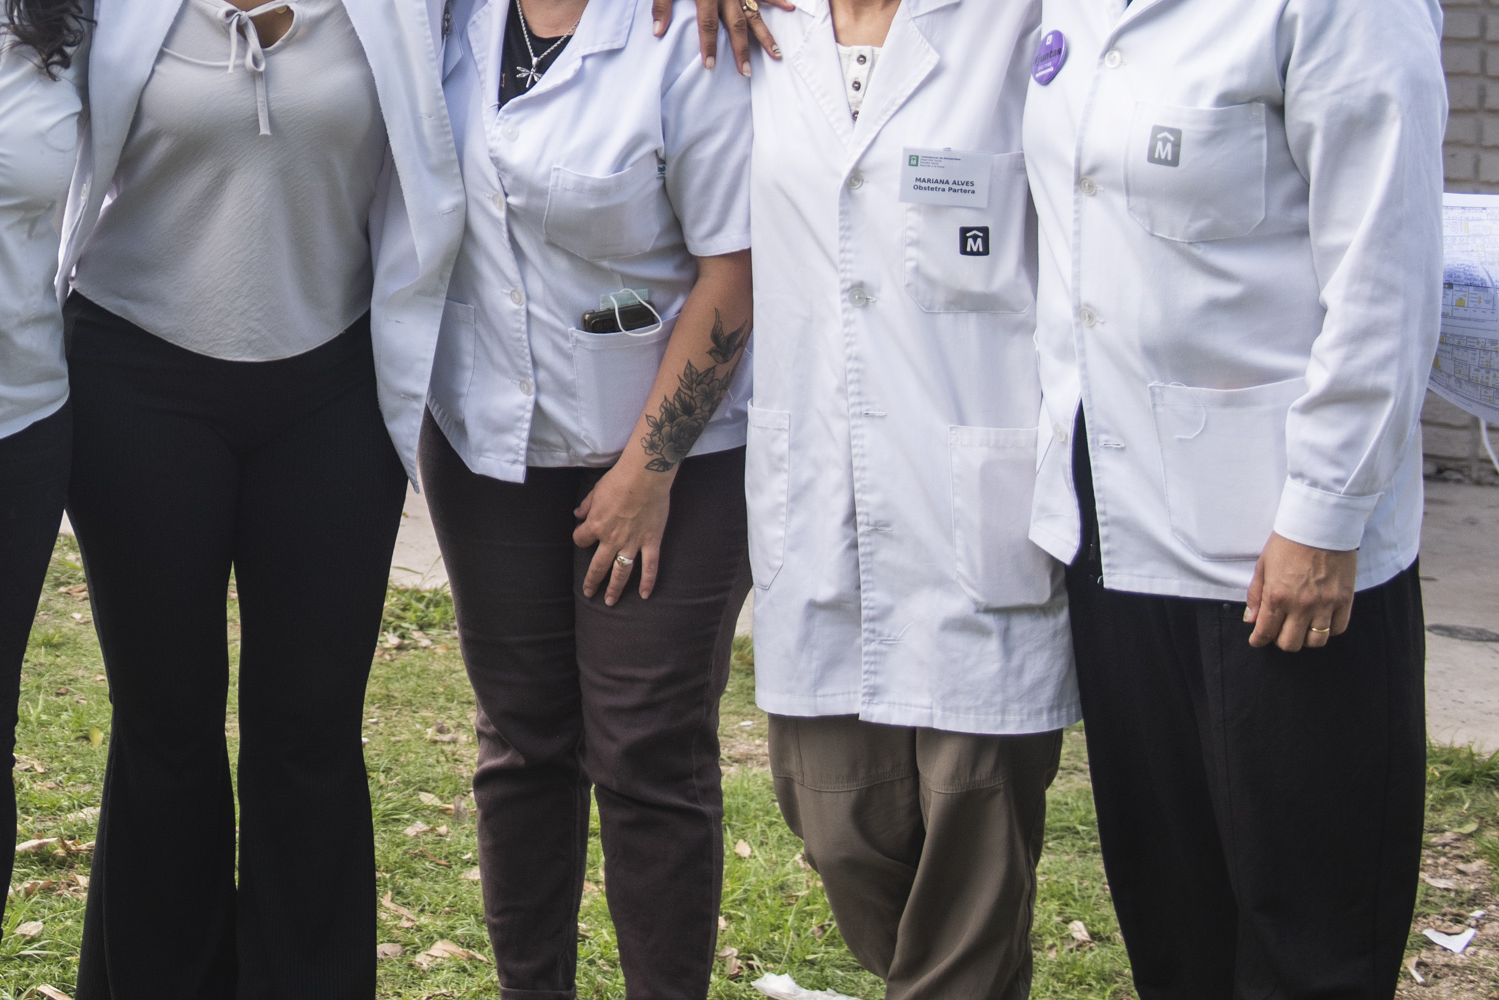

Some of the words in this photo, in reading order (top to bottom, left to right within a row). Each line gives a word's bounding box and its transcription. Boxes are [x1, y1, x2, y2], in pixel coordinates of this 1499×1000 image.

[1154, 140, 1172, 161] M
[915, 177, 950, 185] MARIANA
[951, 179, 975, 187] ALVES
[913, 184, 946, 192] Obstetra
[947, 186, 976, 195] Partera
[966, 237, 983, 252] M
